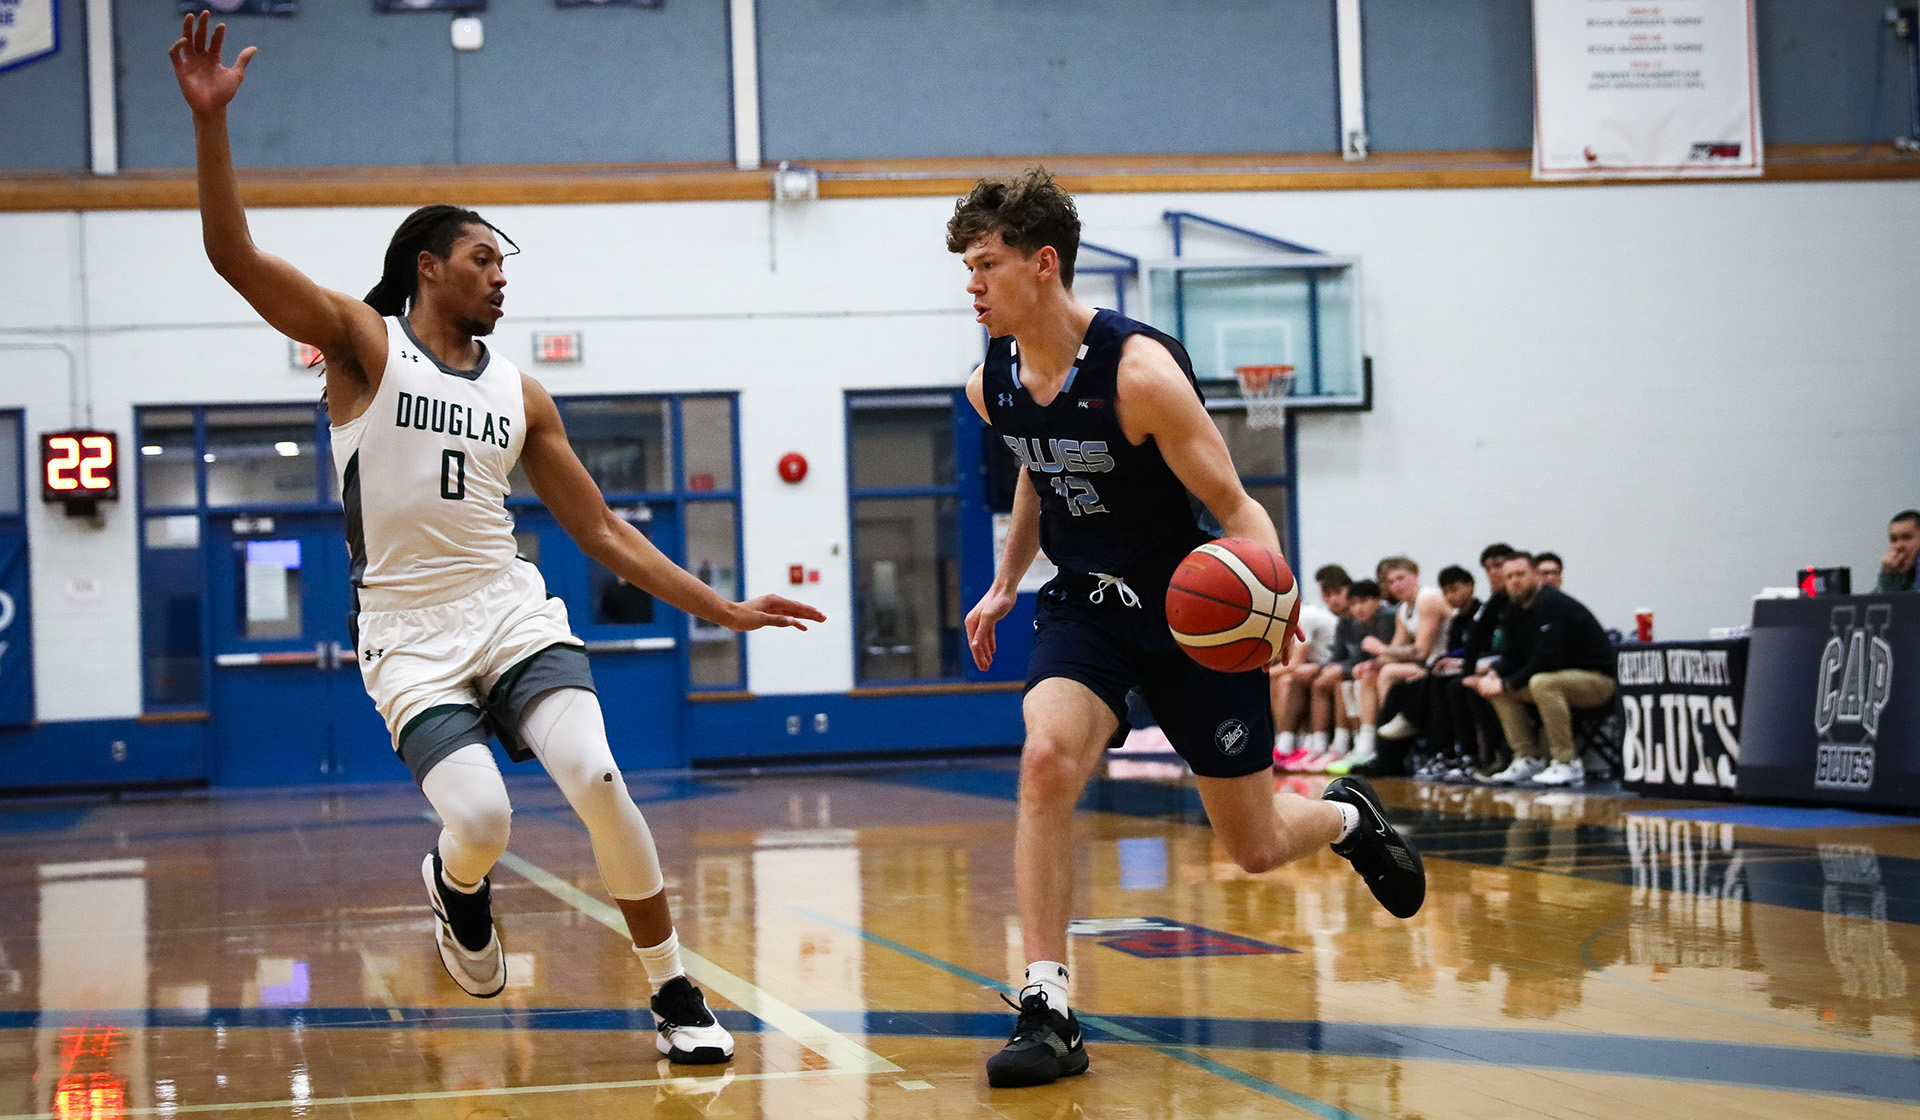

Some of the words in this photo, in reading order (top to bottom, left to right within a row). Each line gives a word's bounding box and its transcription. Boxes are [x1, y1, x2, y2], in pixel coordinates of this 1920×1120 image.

[396, 391, 511, 449] DOUGLAS
[47, 436, 113, 490] 22
[441, 448, 465, 500] 0
[1003, 434, 1115, 473] BLUES
[1050, 476, 1110, 516] 12
[1815, 631, 1893, 738] CAP
[1622, 694, 1740, 787] BLUES
[1815, 745, 1875, 790] BLUES
